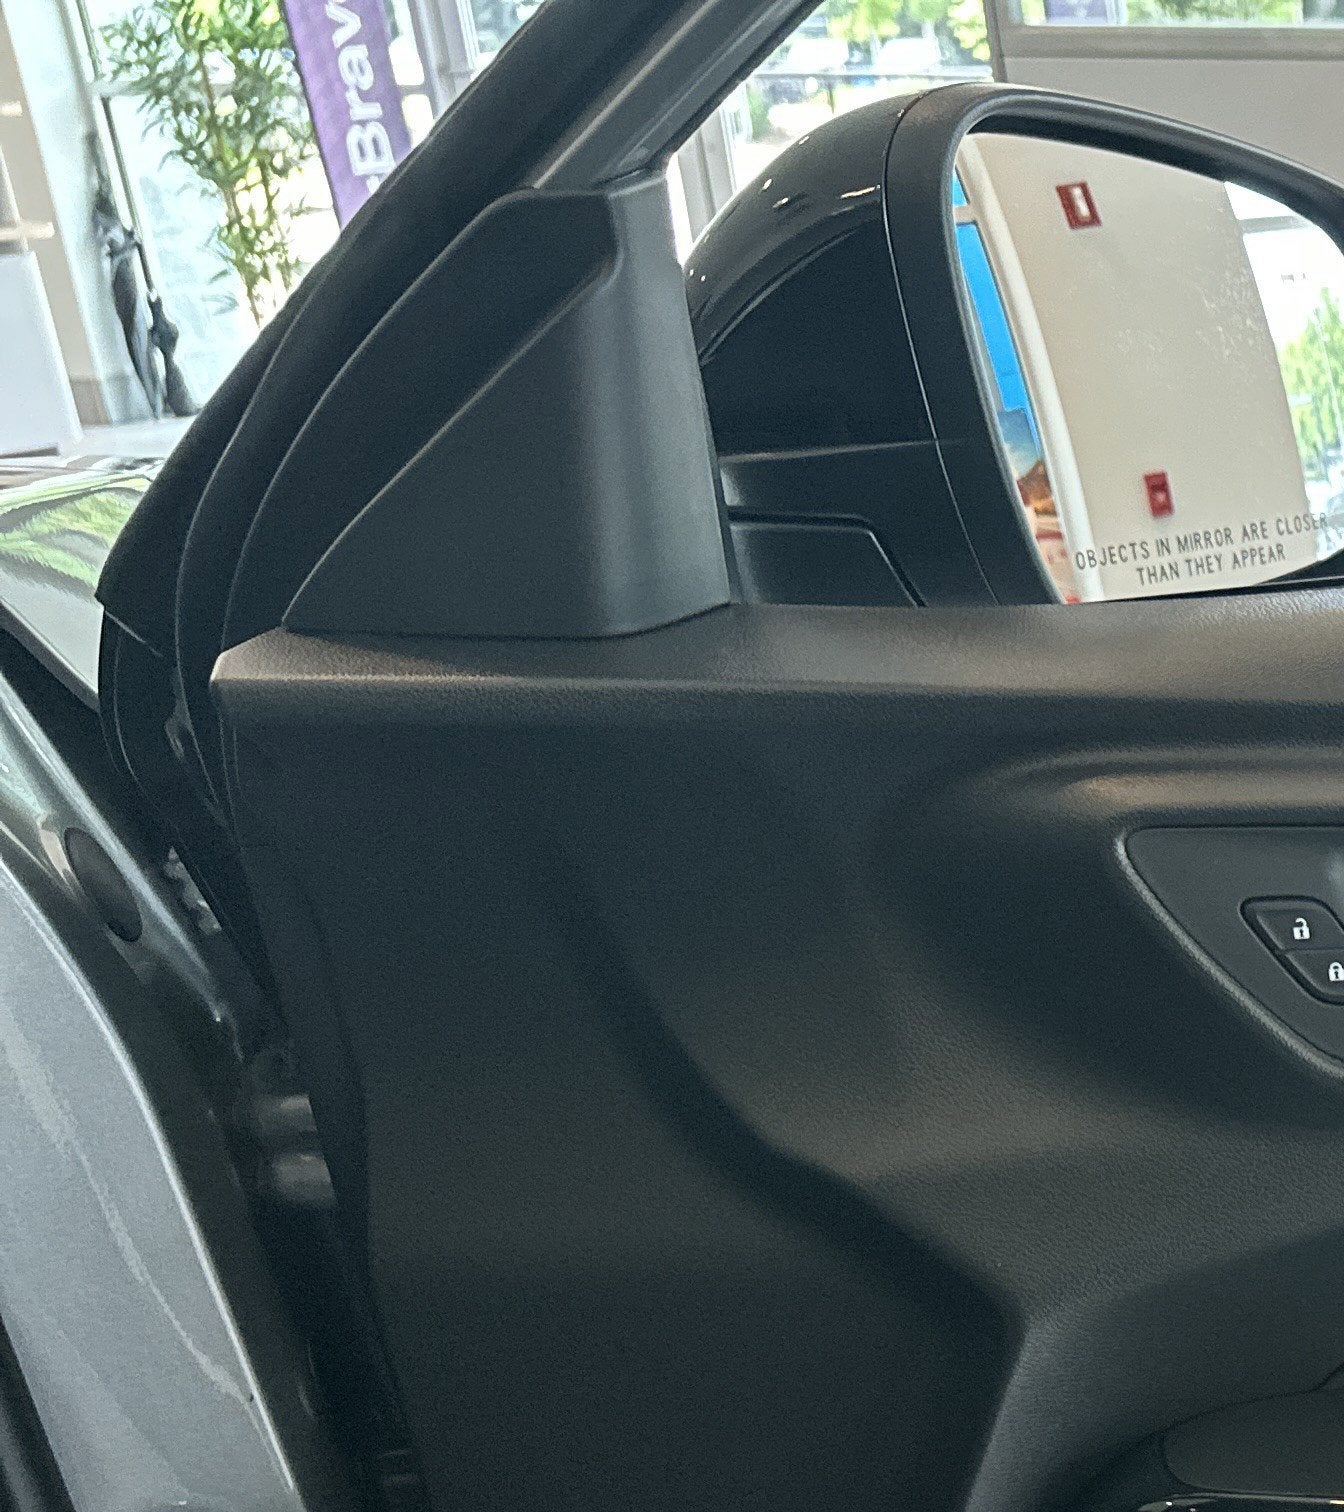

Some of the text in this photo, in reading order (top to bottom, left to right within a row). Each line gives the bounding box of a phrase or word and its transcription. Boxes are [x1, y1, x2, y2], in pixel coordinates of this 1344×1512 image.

[1075, 512, 1328, 570] OBJECTS IN MIRROR ARE CLOSER
[1136, 543, 1286, 586] THAN THEY APPEAR
